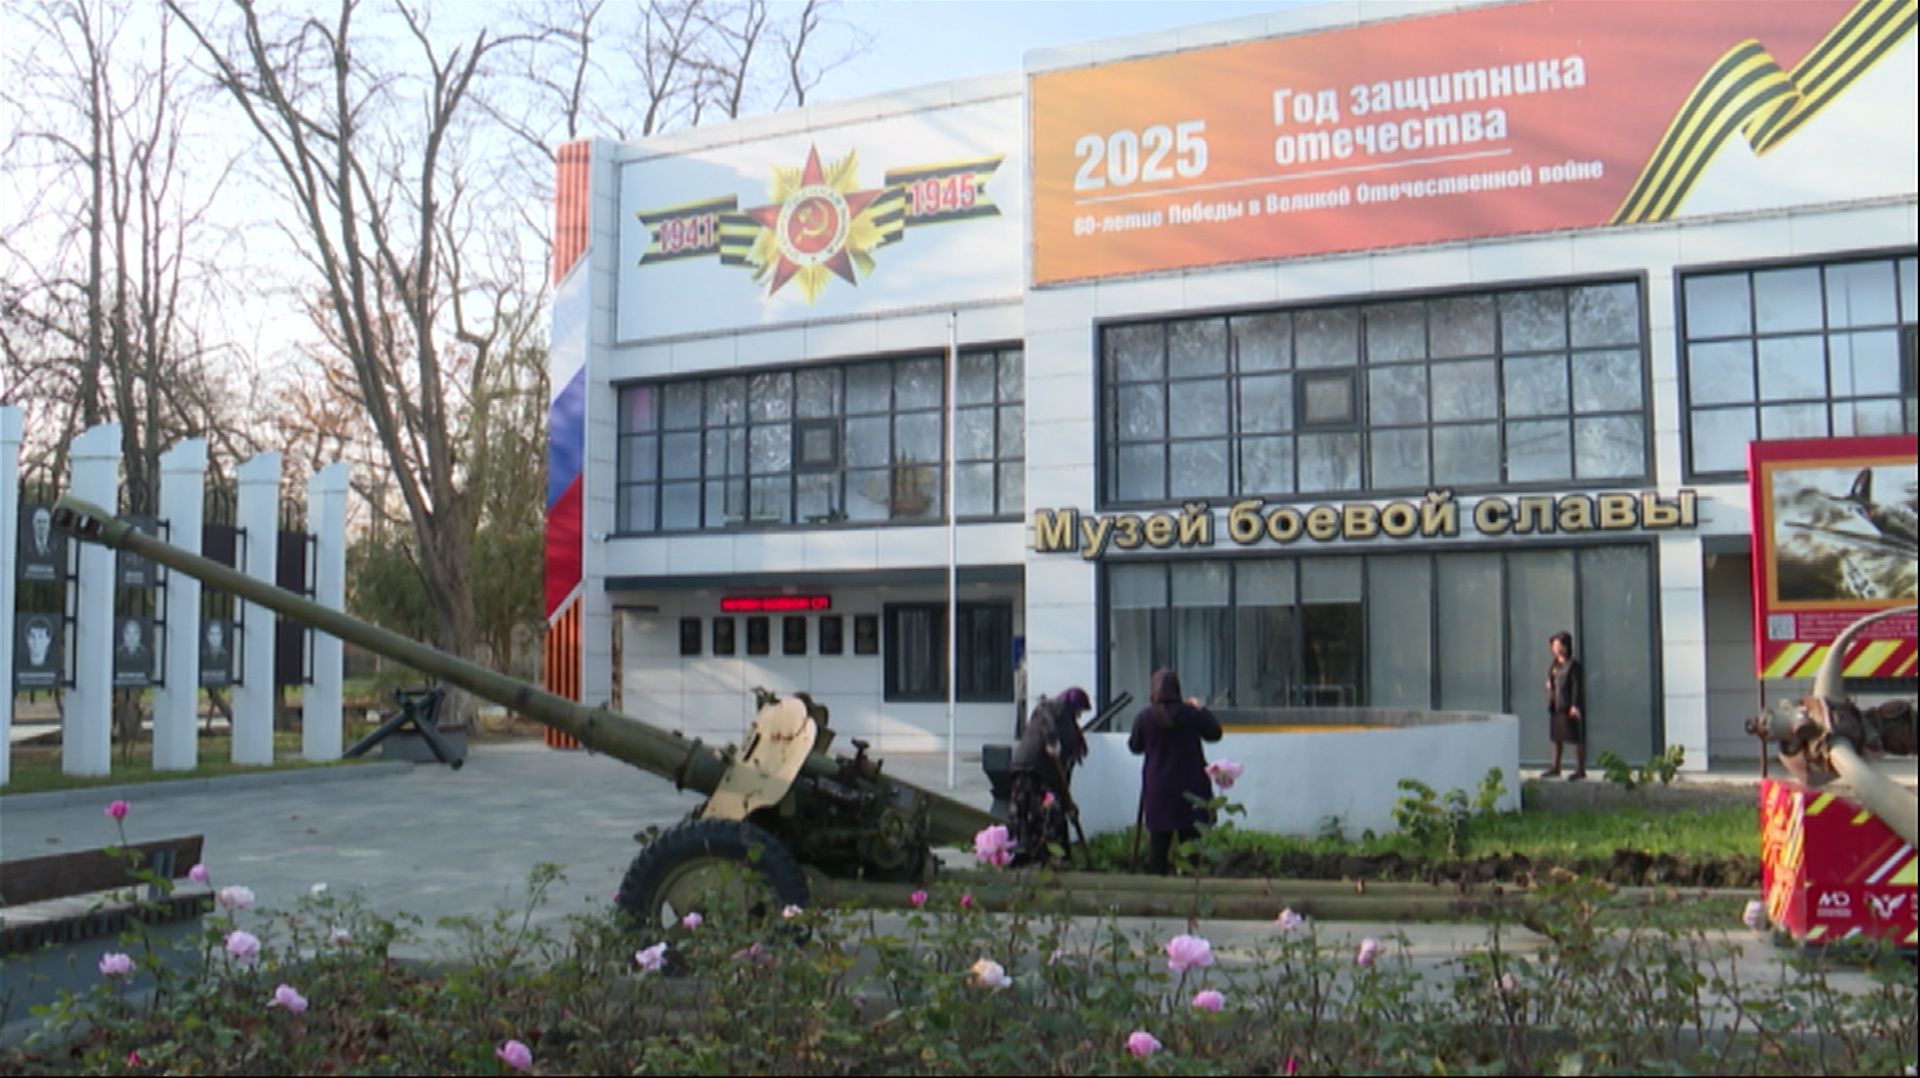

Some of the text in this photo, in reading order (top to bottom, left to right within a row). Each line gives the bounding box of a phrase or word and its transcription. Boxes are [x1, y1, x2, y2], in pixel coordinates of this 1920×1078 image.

[1272, 54, 1585, 126] Год защитника
[1074, 119, 1209, 192] 2025
[1275, 107, 1507, 166] отечества
[909, 172, 977, 217] 1945
[1073, 159, 1604, 237] 80-летие Победы в Великой Отечественной войне
[657, 214, 716, 253] 1941
[1034, 488, 1698, 560] Музей боевой славы
